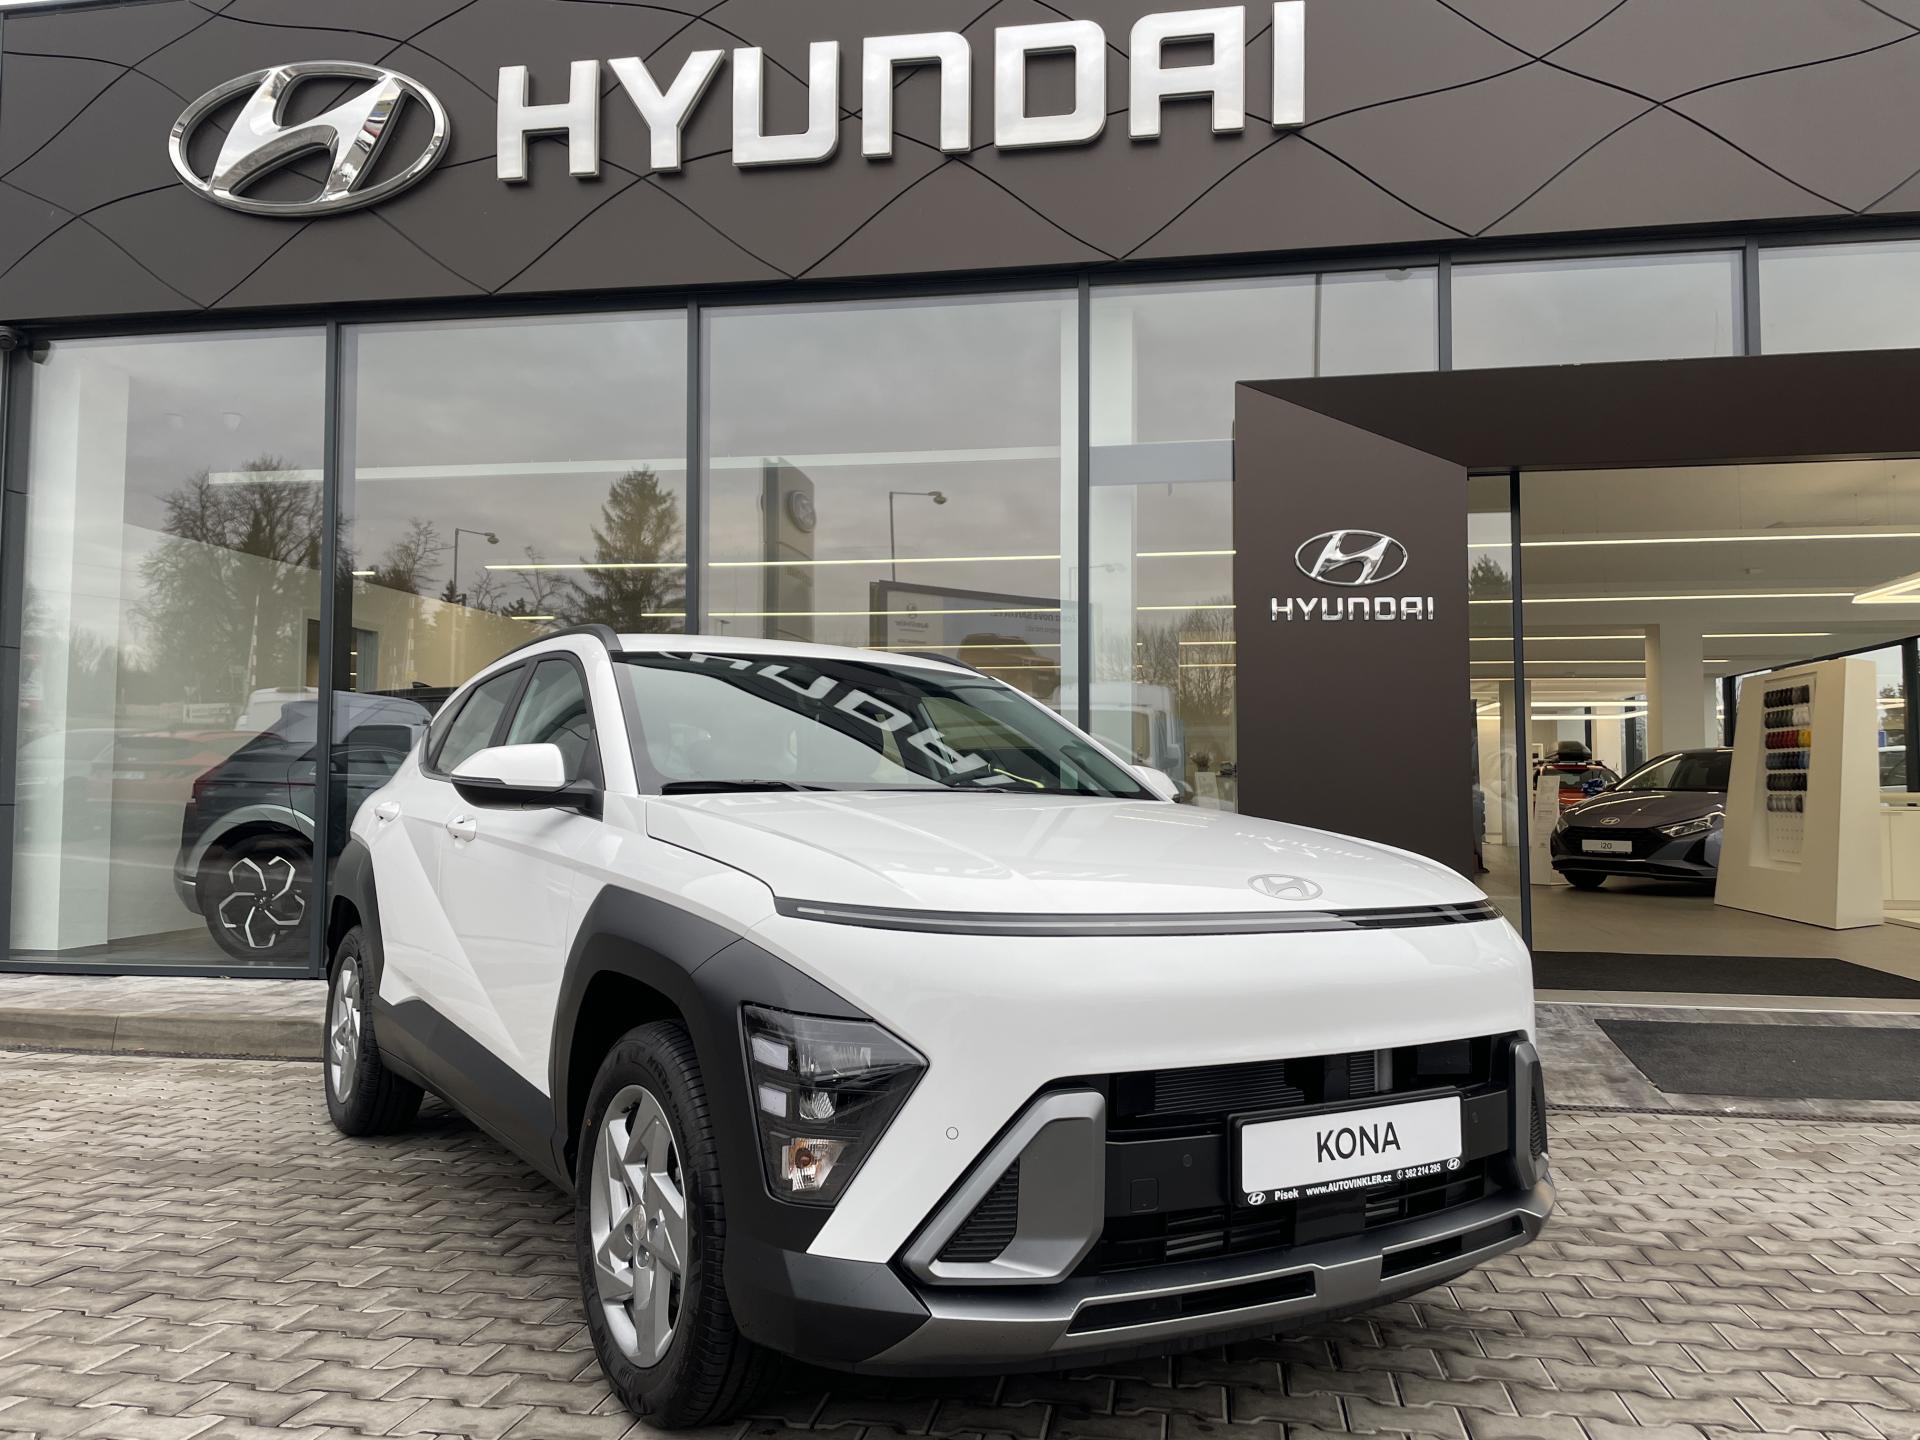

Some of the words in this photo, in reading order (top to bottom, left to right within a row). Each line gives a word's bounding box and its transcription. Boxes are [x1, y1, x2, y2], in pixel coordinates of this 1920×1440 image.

[495, 0, 1306, 184] HYUNDAI
[1271, 596, 1434, 621] HYUNDAI
[1316, 1122, 1401, 1163] KONA
[1306, 1174, 1392, 1196] www.AUTOVINKLER.cz
[1405, 1168, 1417, 1178] 382
[1418, 1166, 1429, 1176] 214
[1430, 1163, 1441, 1174] 295
